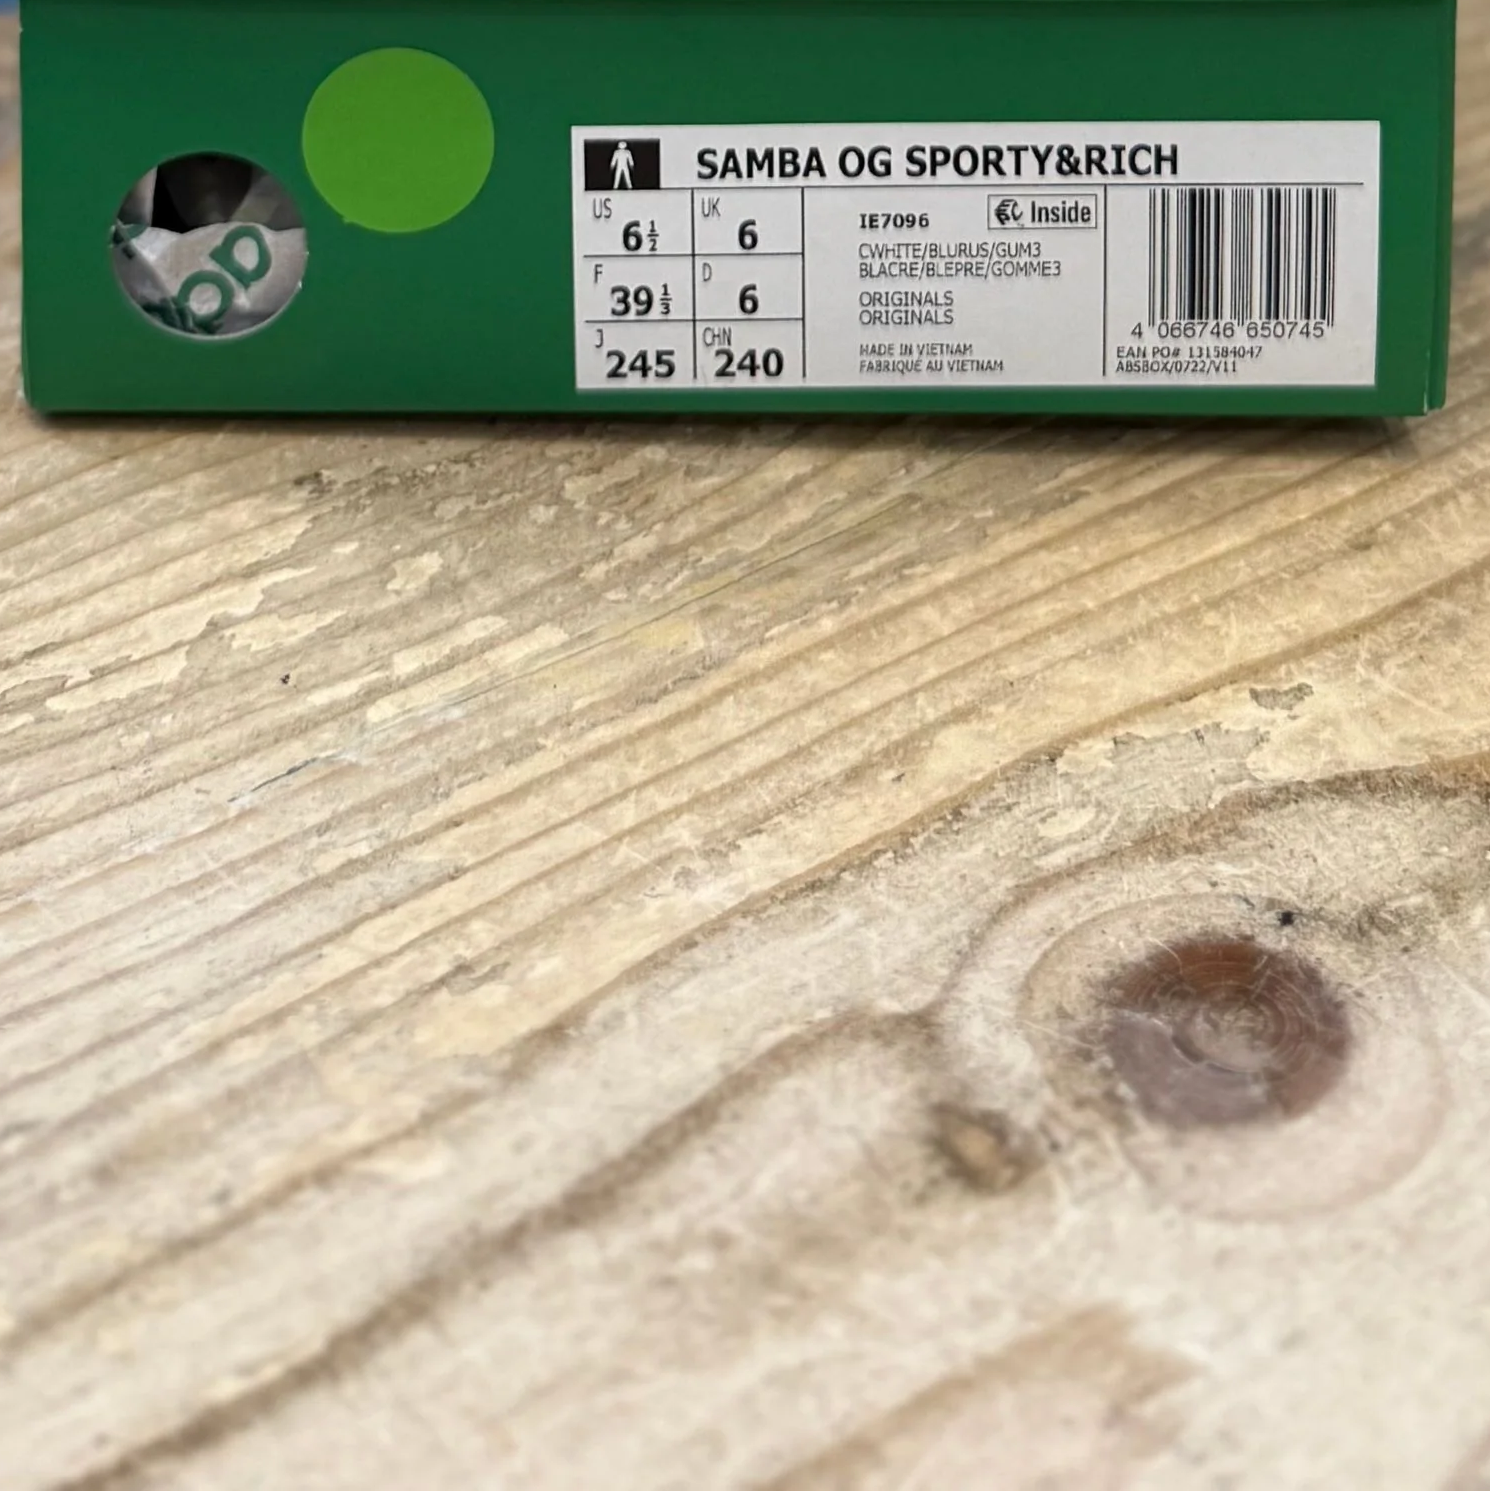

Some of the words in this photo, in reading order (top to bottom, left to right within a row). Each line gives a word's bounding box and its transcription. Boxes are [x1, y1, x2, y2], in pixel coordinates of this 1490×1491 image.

[696, 146, 826, 180] SAMBA
[838, 146, 892, 179] OG
[905, 143, 1179, 177] SPORTY&RICH
[592, 197, 613, 219] US
[701, 196, 721, 217] UK
[1031, 200, 1092, 224] Inside
[859, 213, 930, 230] IE7096
[738, 218, 758, 250] 6
[859, 241, 1042, 261] CWHITE/BLURUS/GUM3
[593, 263, 604, 284] F
[702, 262, 713, 282] D
[859, 260, 1061, 280] BLACRE/BLEPRE/GOMME3
[739, 283, 759, 315] 6
[859, 291, 954, 307] ORIGINALS
[859, 309, 954, 326] ORIGINALS
[594, 328, 605, 349] J
[702, 327, 732, 347] CHN
[1131, 321, 1143, 339] 4
[1157, 321, 1235, 339] 066746
[1246, 321, 1325, 339] 650745
[859, 343, 895, 356] MADE
[900, 343, 913, 356] IN
[917, 342, 973, 356] VIETNAM
[1117, 346, 1146, 359] EAN
[1152, 346, 1181, 359] PO#
[1188, 345, 1263, 359] 131584047
[606, 349, 676, 379] 245
[714, 347, 784, 377] 240
[926, 359, 943, 372] AU
[947, 359, 1004, 372] VIETNAM
